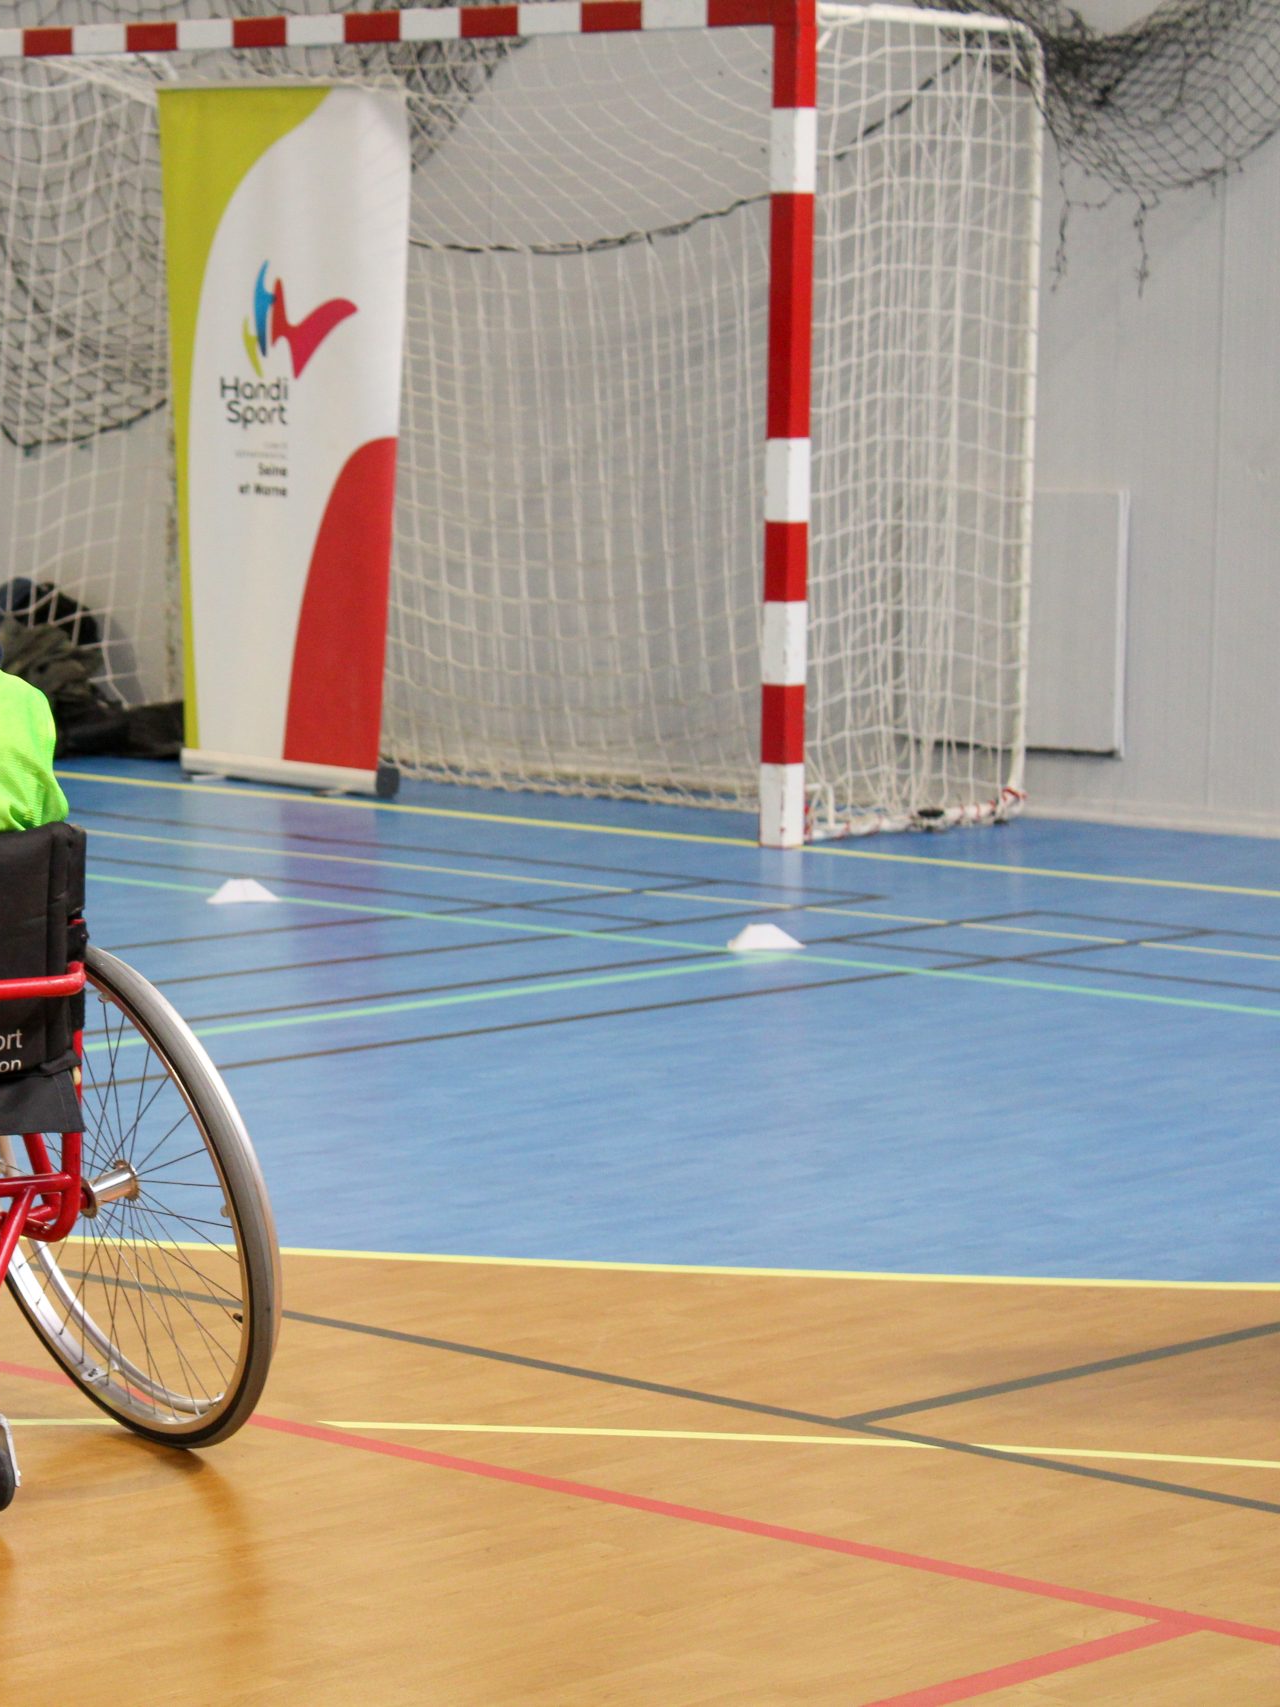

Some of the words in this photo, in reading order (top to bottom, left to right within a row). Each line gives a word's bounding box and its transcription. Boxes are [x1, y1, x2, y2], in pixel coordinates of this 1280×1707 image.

[219, 376, 288, 401] Handi
[226, 400, 288, 429] Sport
[258, 462, 288, 477] Seine
